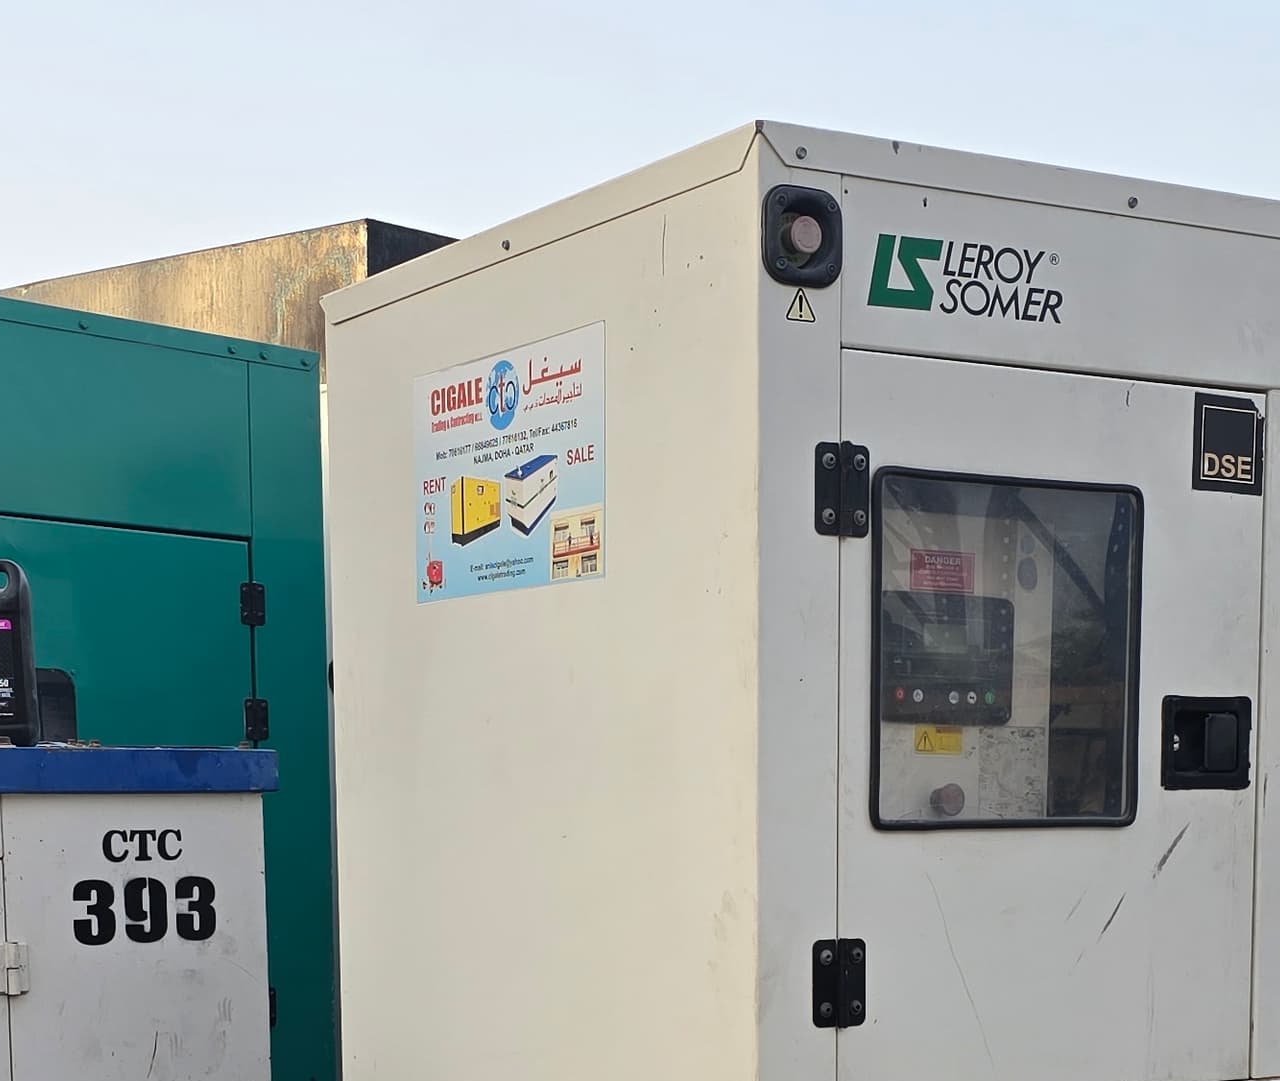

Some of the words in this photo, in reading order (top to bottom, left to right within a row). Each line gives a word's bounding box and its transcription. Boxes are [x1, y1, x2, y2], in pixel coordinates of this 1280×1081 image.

[942, 240, 1046, 284] LEROY
[939, 278, 1064, 324] SOMER
[431, 377, 483, 416] CIGALE
[514, 443, 535, 456] QATAR
[566, 444, 595, 466] SALE
[1202, 452, 1253, 480] DSE
[423, 476, 447, 496] RENT
[102, 829, 183, 862] CTC
[72, 876, 217, 946] 393
